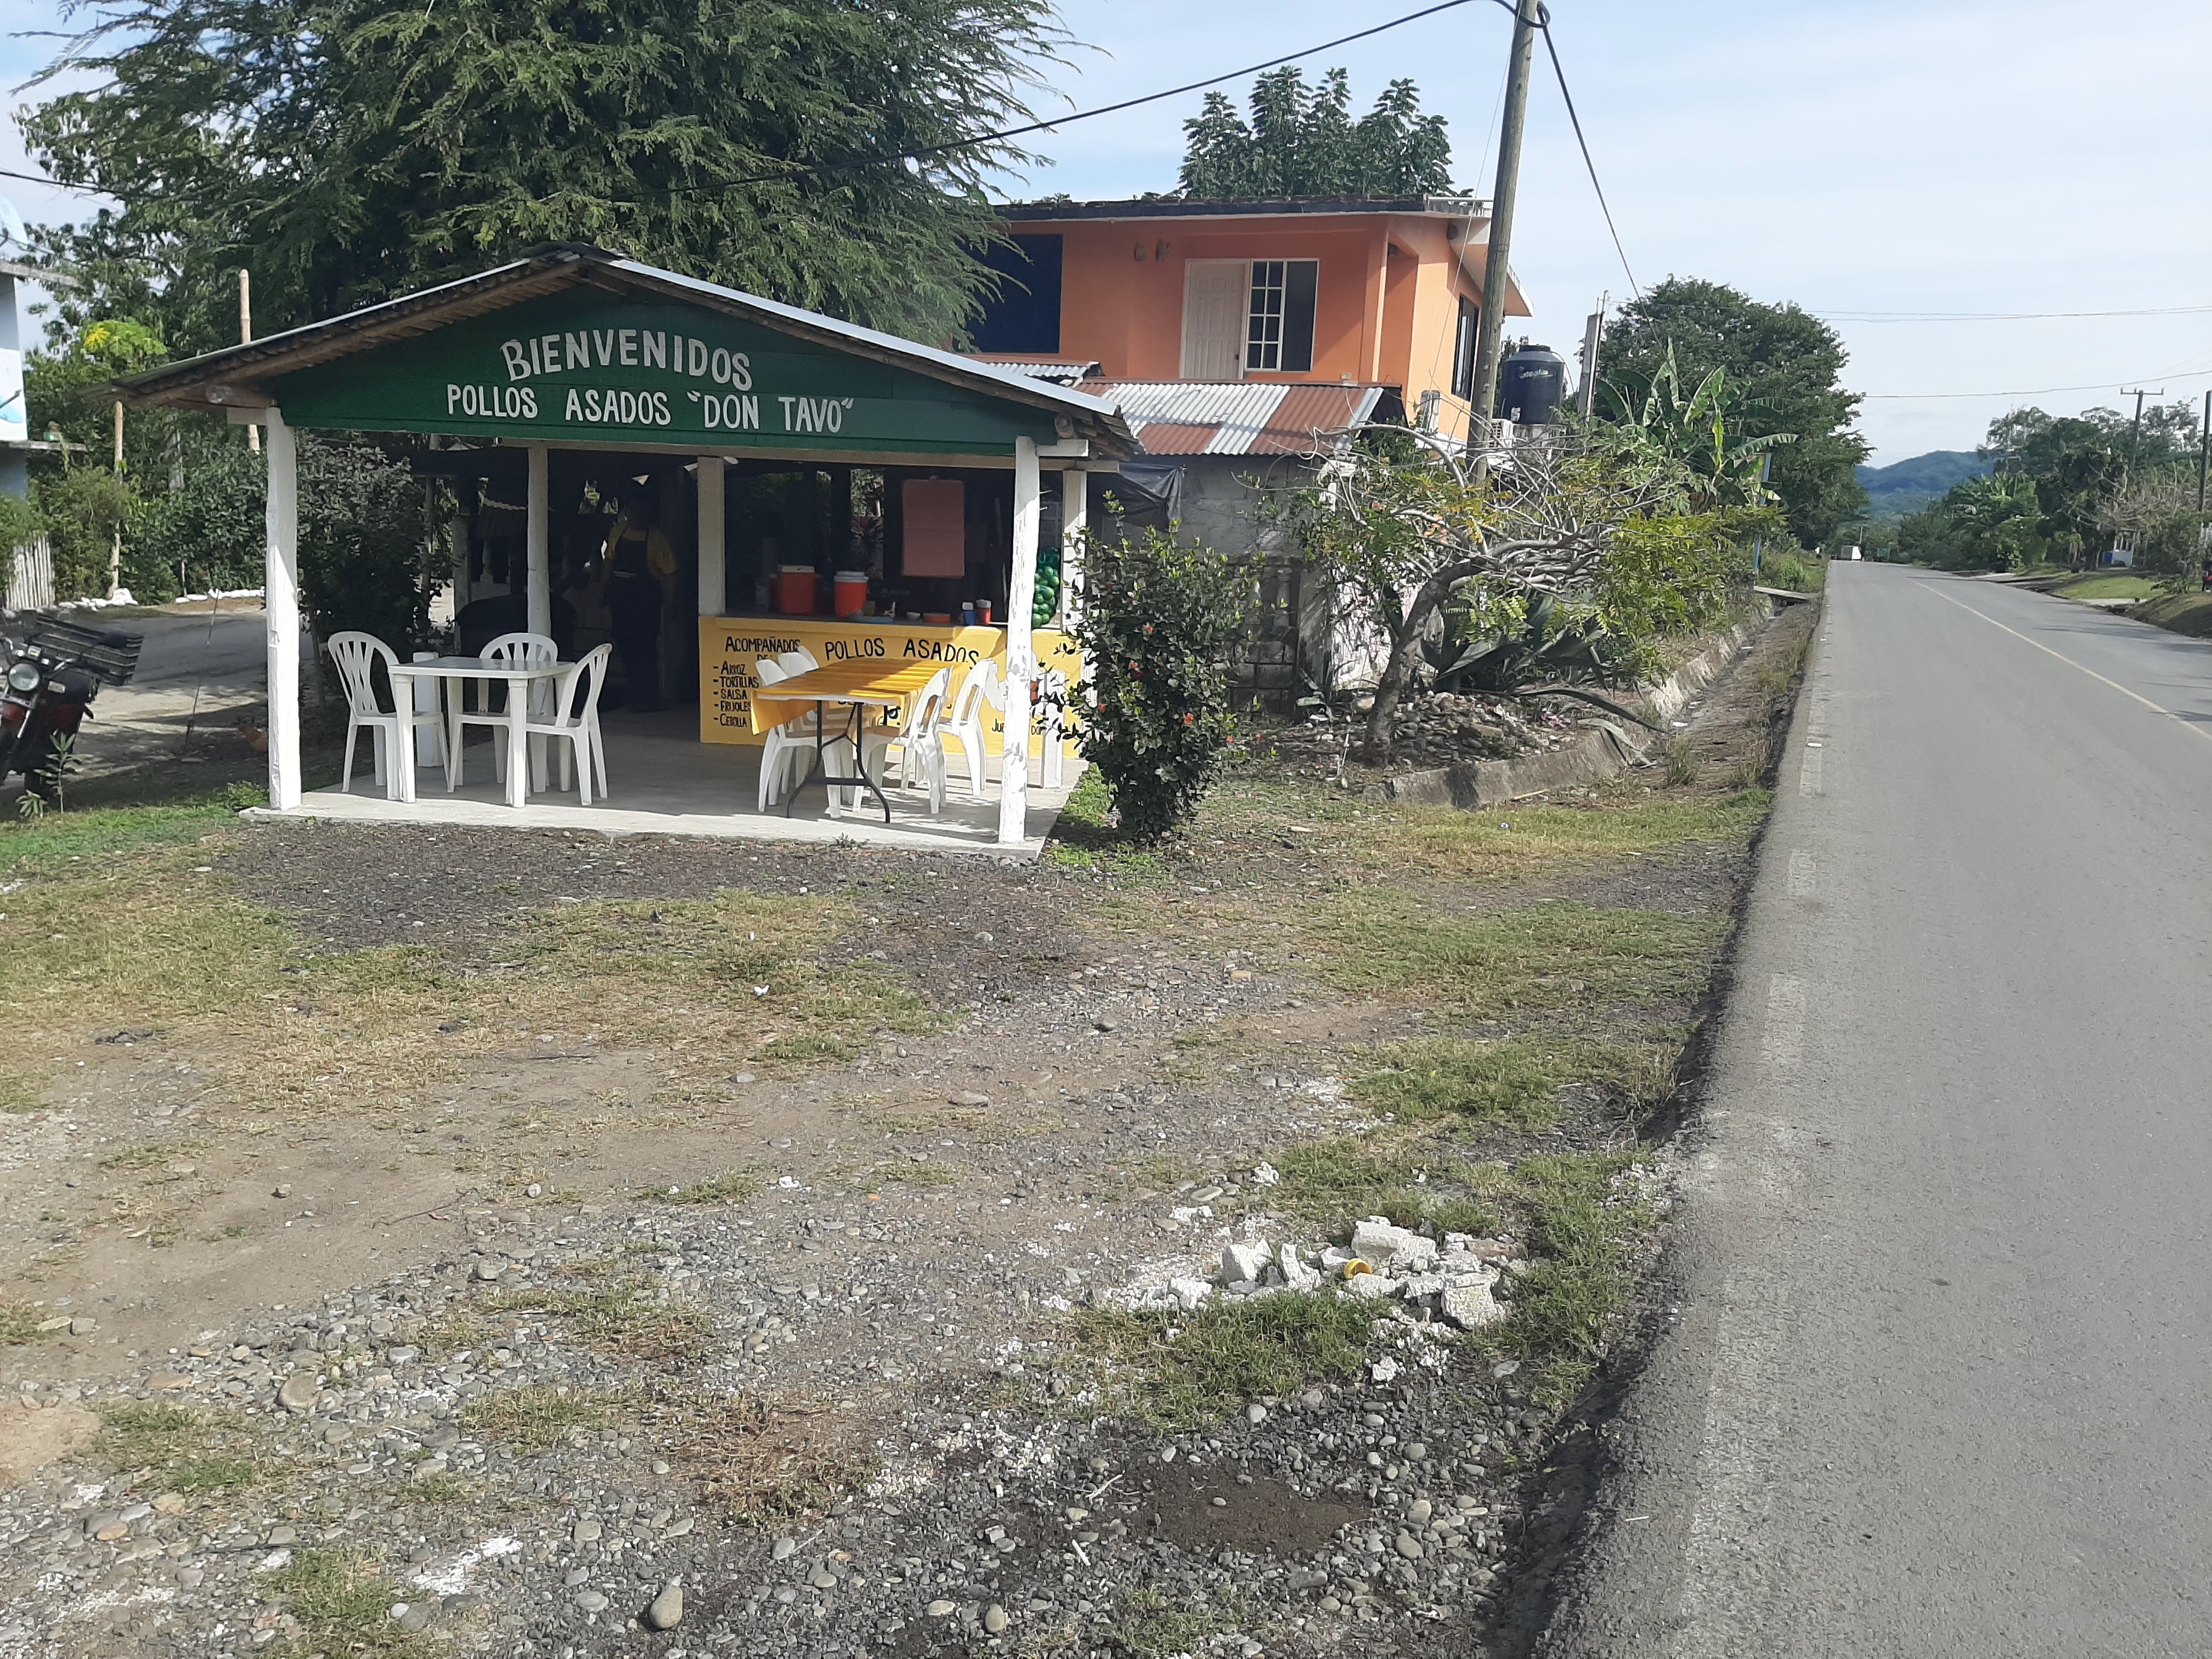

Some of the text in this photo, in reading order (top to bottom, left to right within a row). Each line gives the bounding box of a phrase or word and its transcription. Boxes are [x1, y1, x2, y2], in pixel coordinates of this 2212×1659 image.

[500, 329, 753, 391] BIENVENIDOS
[447, 384, 538, 418] POLLOS
[566, 388, 671, 425] ASADOS
[725, 636, 800, 652] ACOMPAÑADOS
[825, 638, 979, 669] POLLOS ASADOS
[719, 676, 759, 688] TORTILLAS
[721, 689, 747, 699] SALSA
